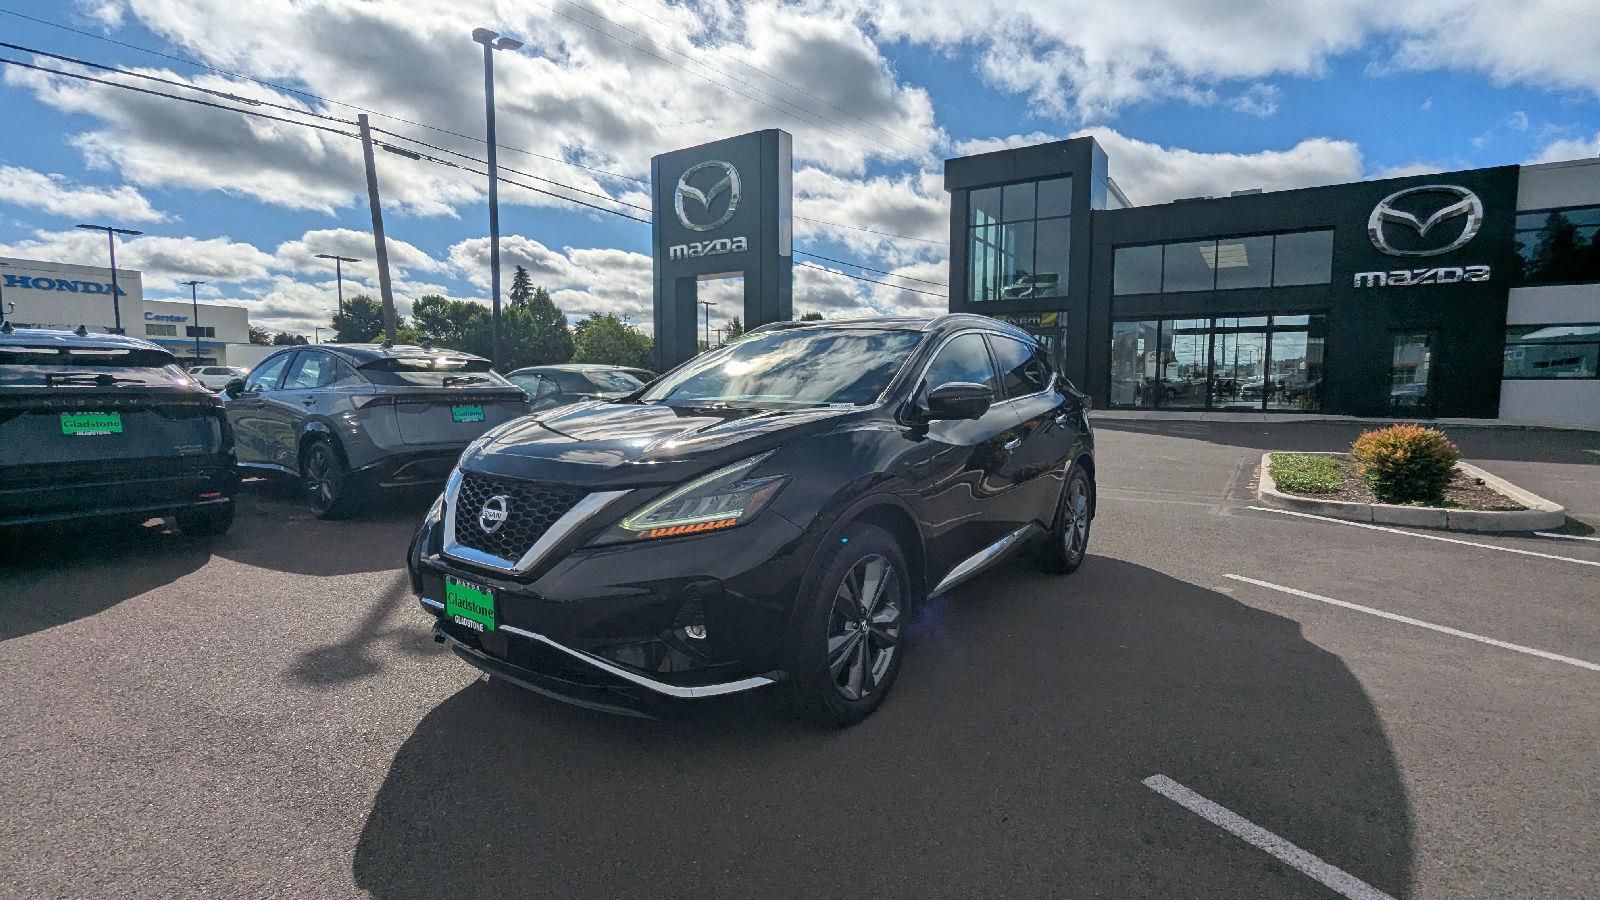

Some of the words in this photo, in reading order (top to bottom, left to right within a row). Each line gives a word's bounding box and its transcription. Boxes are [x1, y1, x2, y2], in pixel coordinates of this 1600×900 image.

[3, 274, 127, 296] HONDA
[144, 311, 188, 322] Center
[63, 420, 120, 428] Gladstone
[456, 579, 480, 592] MAZDA
[448, 592, 494, 619] Gladstone
[454, 614, 484, 632] GLADSTONE
